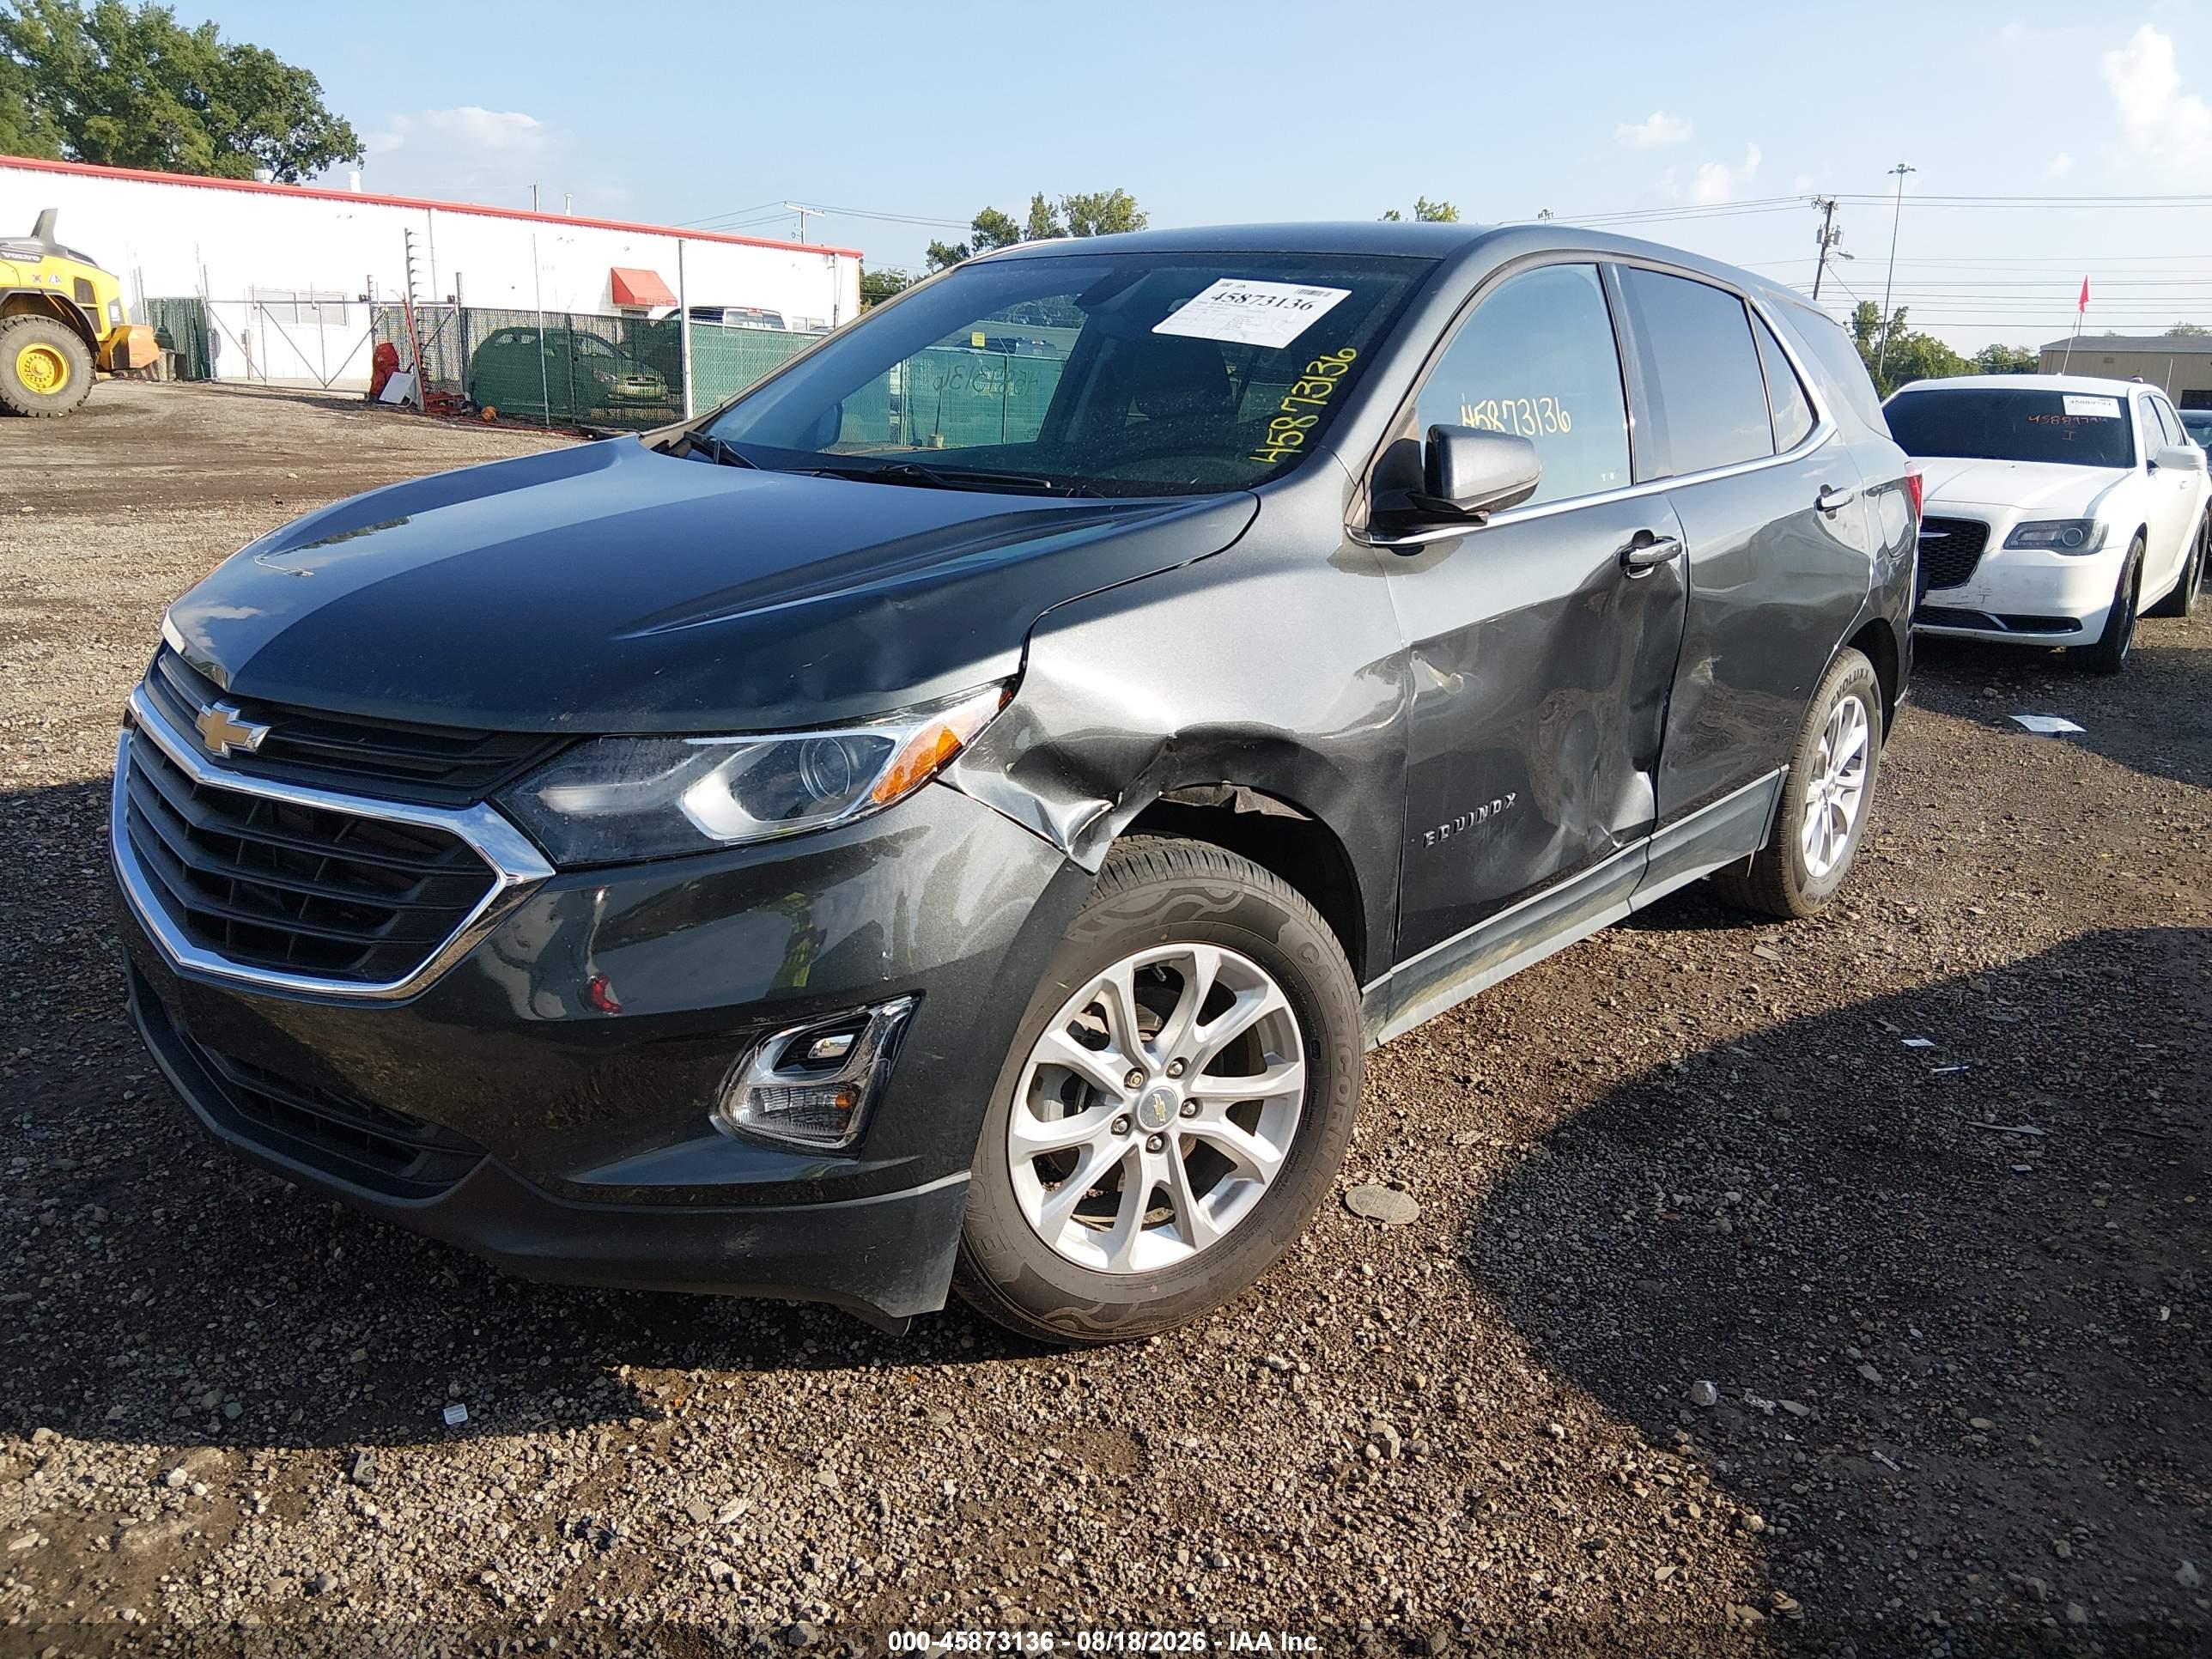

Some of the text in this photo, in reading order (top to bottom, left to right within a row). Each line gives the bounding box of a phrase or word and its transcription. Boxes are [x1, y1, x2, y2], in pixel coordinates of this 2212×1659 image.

[1, 252, 40, 261] VOLVO
[1211, 291, 1317, 311] 45873136
[1249, 348, 1357, 463] 45873136
[1462, 397, 1571, 436] 45873136
[1830, 667, 1869, 712] EVOLUXX
[1423, 792, 1516, 848] EQUINOX
